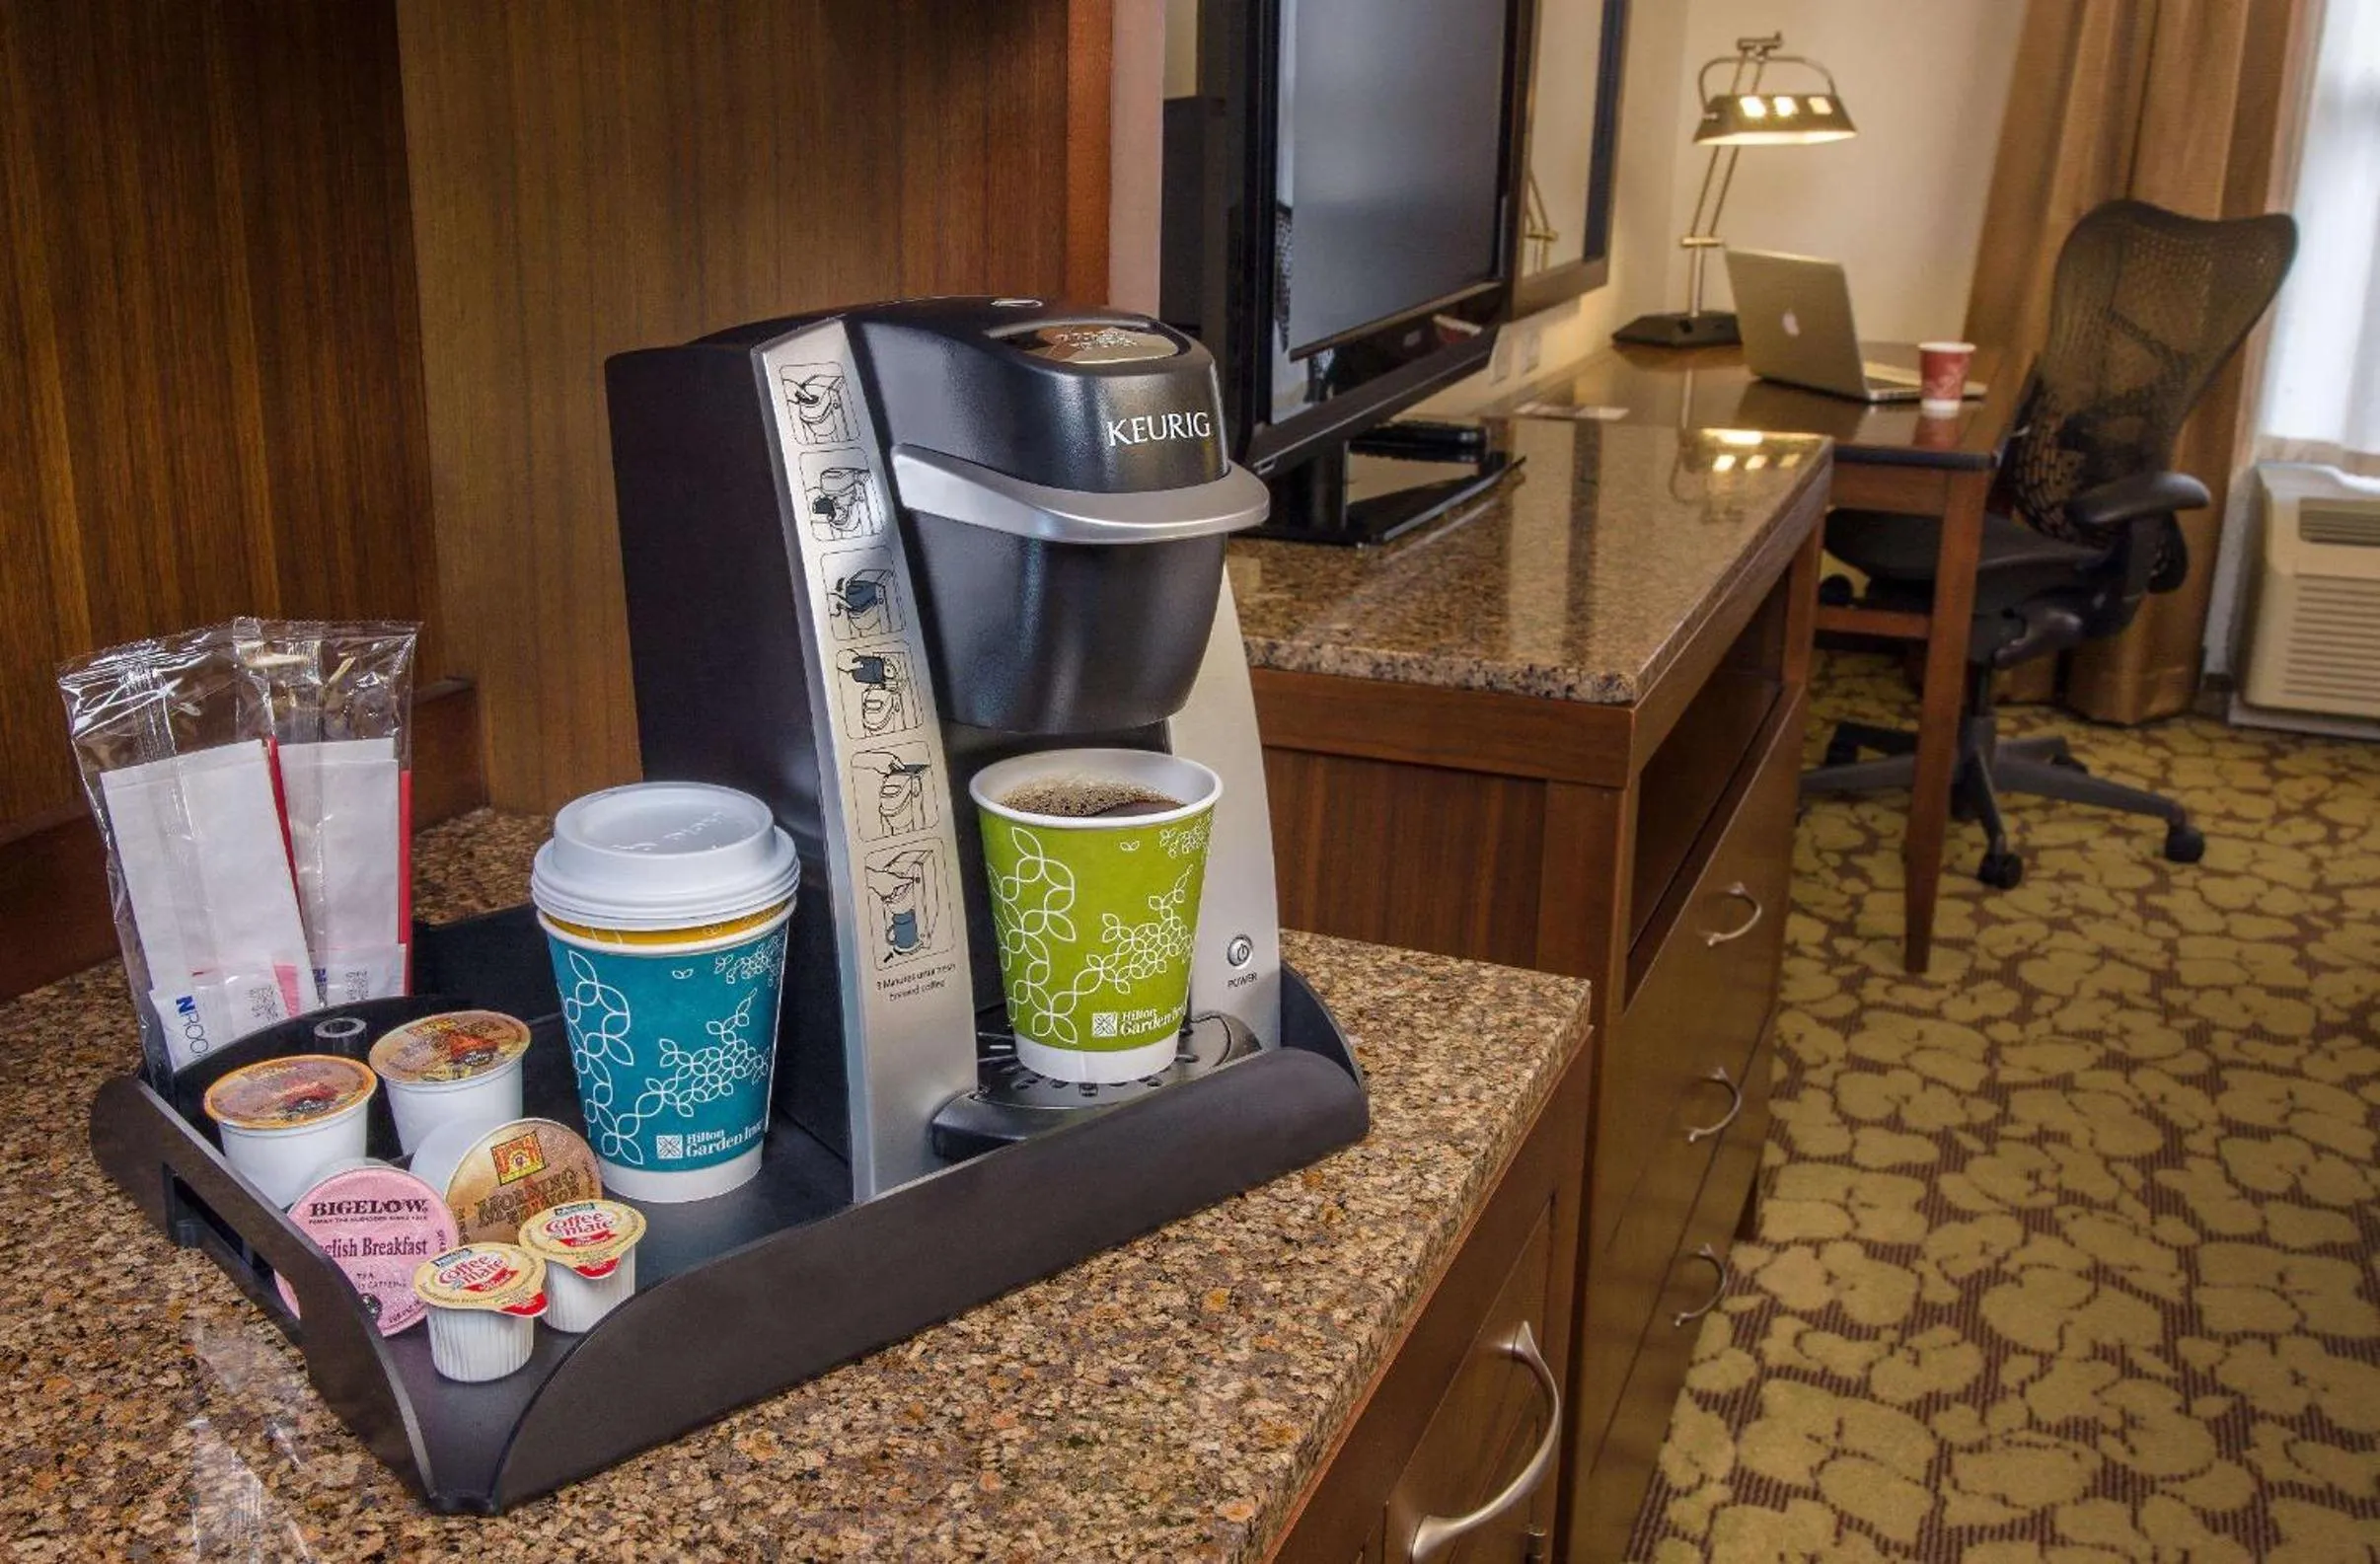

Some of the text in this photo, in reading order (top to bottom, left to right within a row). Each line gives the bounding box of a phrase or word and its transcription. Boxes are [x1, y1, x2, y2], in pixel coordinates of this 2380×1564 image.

[1106, 411, 1212, 447] KEURIG
[1227, 972, 1258, 988] POWER
[1120, 1014, 1172, 1036] Garden
[1122, 1008, 1157, 1022] Hilton
[686, 1129, 725, 1145] Hilton
[686, 1133, 742, 1157] Garden
[309, 1199, 428, 1217] BIGELOW
[317, 1237, 358, 1258] glish
[361, 1235, 428, 1257] Breakfast
